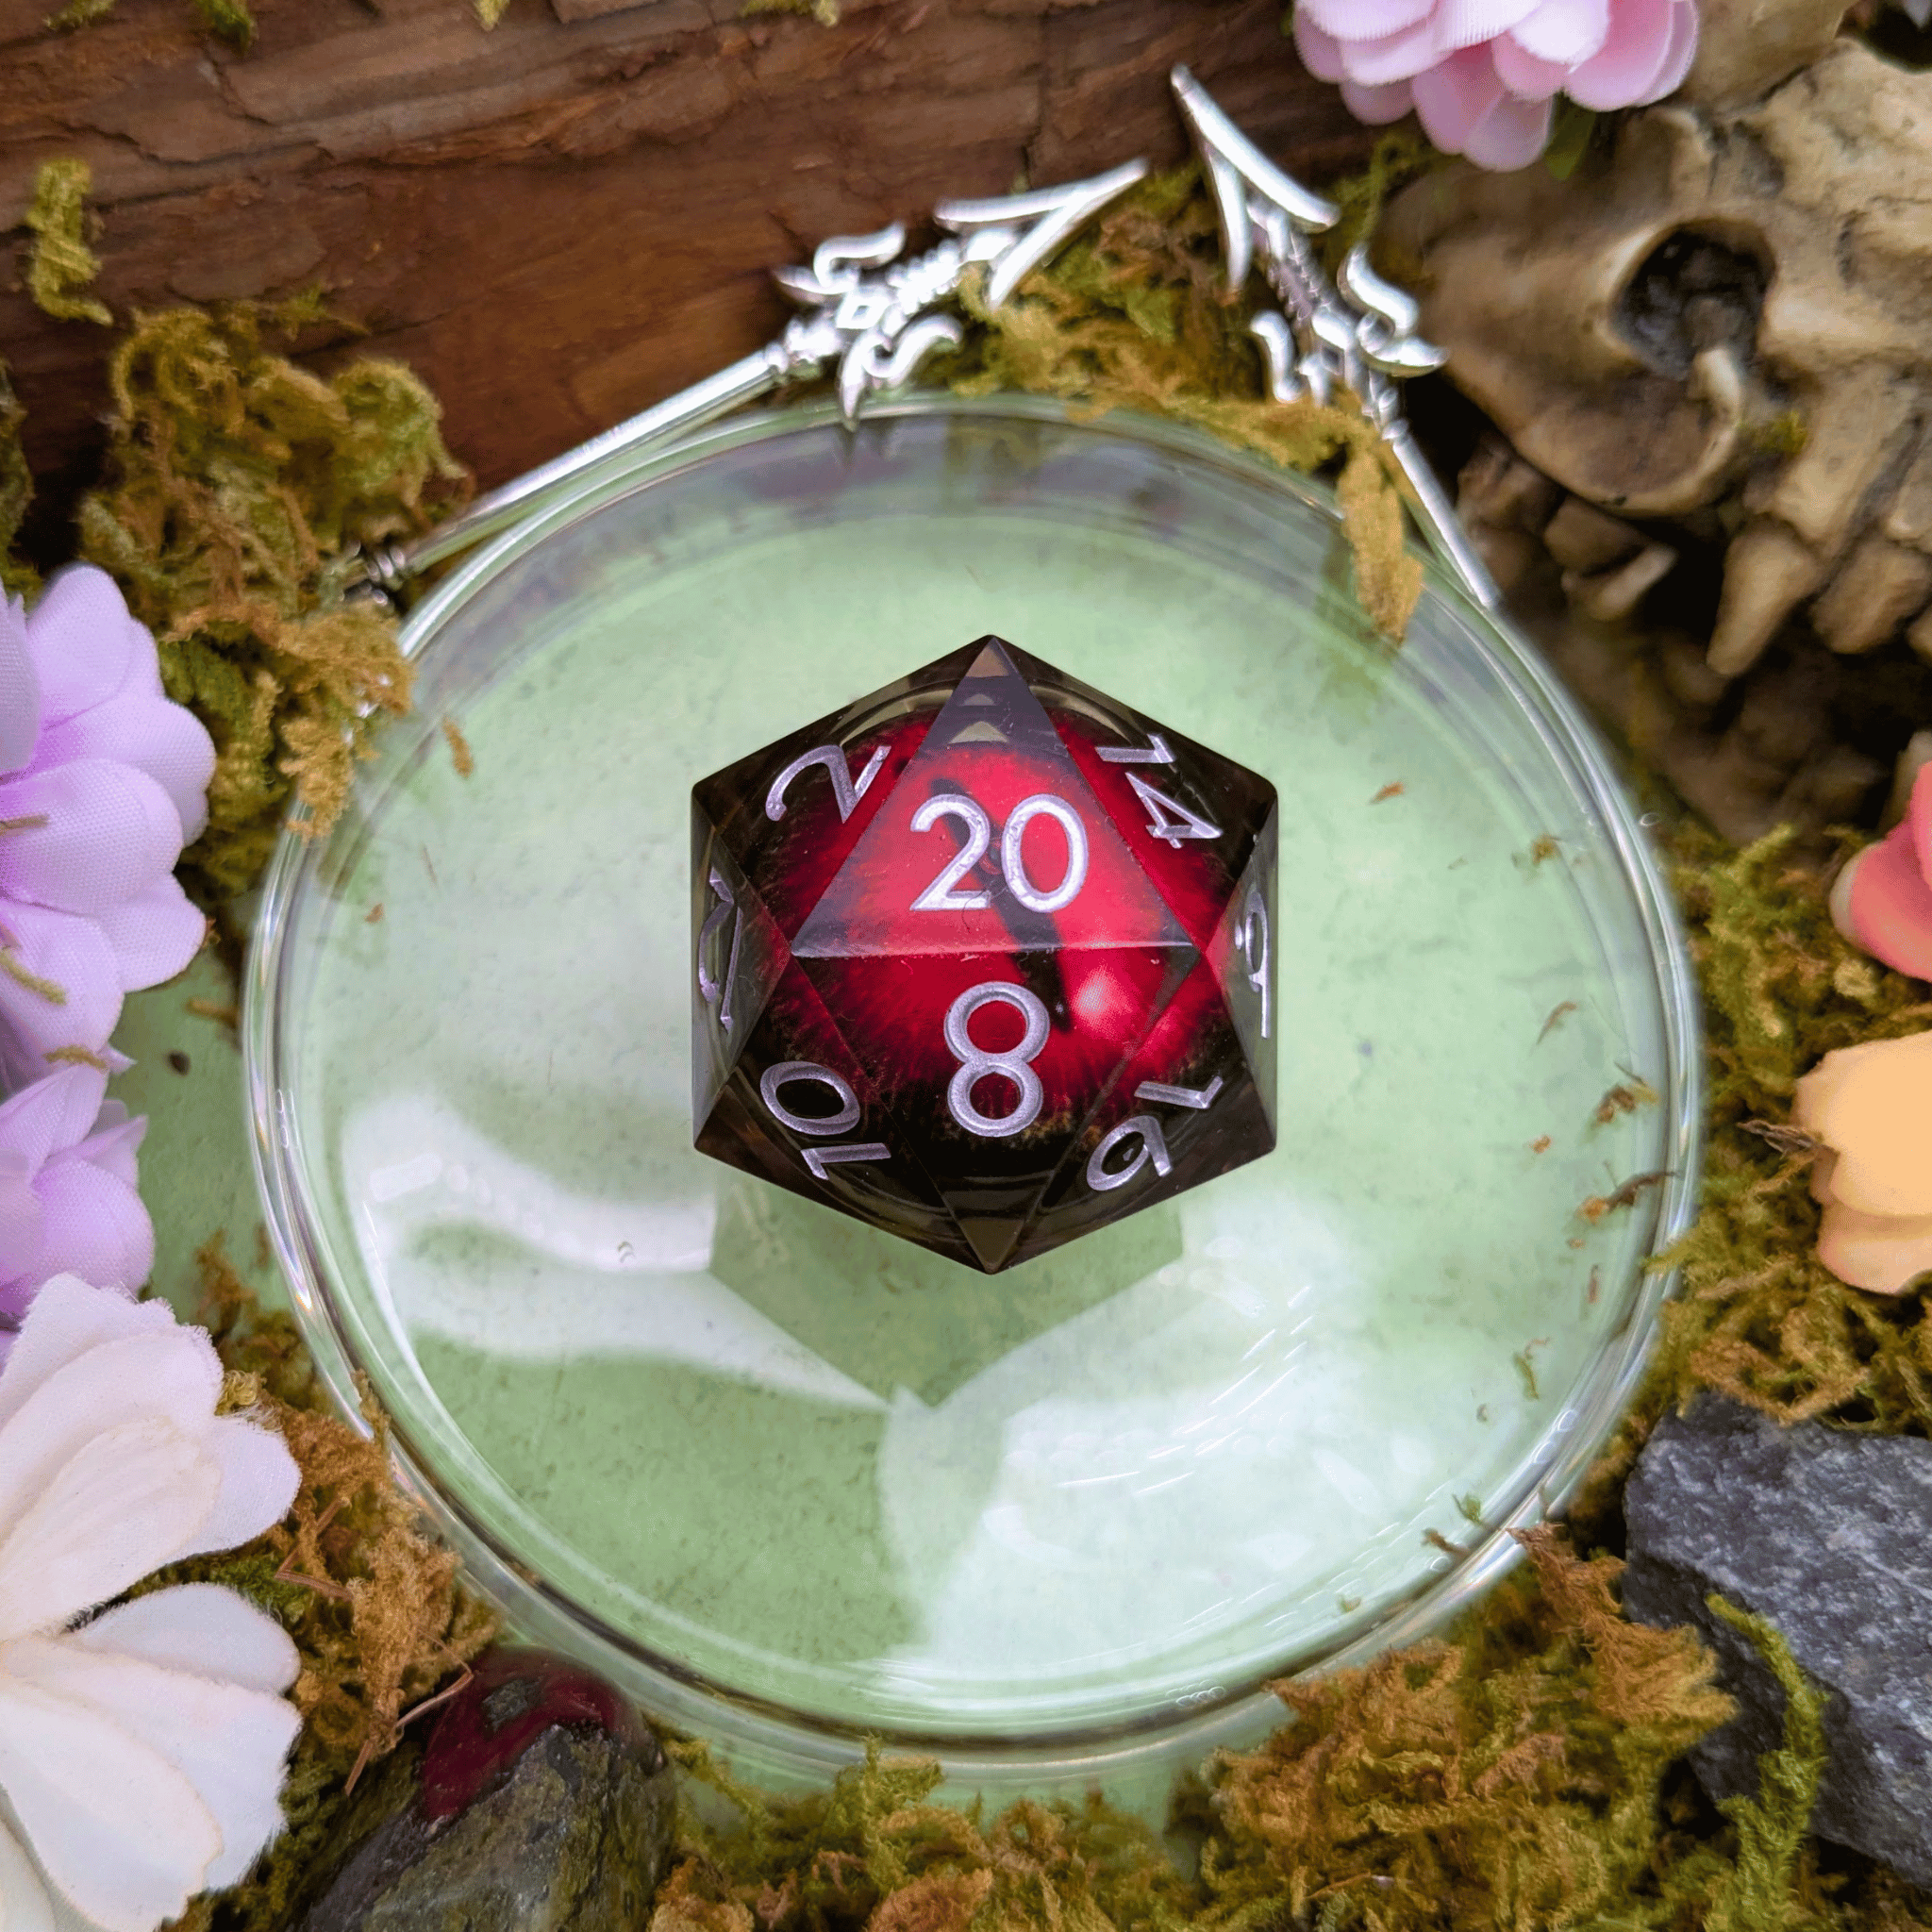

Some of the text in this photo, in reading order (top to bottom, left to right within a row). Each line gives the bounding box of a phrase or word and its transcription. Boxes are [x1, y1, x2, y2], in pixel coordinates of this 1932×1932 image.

[765, 743, 891, 824] 2
[1094, 733, 1224, 849] 14
[909, 793, 1089, 913] 20
[944, 981, 1050, 1138] 8
[759, 1060, 891, 1180] 10
[1086, 1075, 1224, 1191] 16
